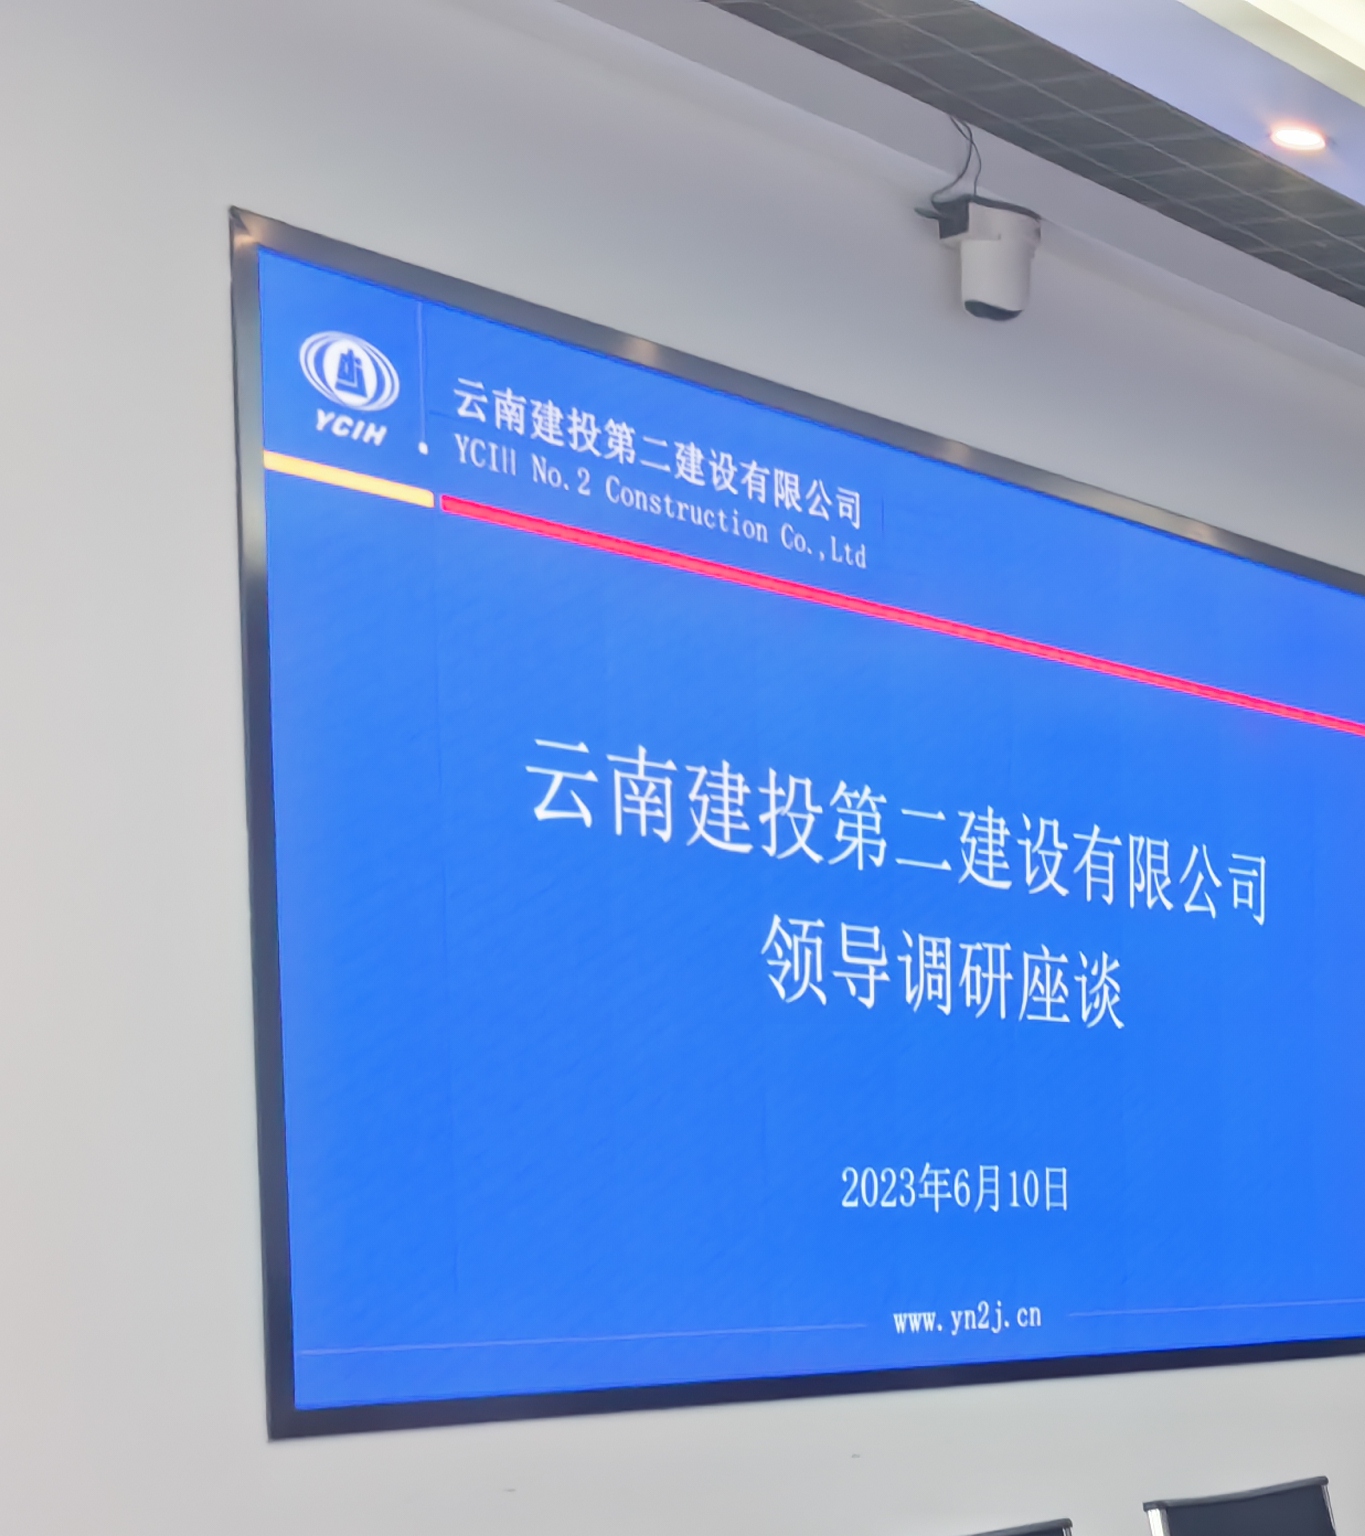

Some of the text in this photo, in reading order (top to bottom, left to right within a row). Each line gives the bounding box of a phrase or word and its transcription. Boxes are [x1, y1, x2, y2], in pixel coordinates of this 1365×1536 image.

[315, 408, 388, 446] YCIH
[453, 377, 862, 530] 云南建投第二建设有限公司
[531, 453, 591, 497] No.2
[605, 475, 769, 544] Construction
[525, 738, 1267, 927] 云南建投第二建设有限公司
[761, 913, 1126, 1029] 领导调研座谈
[841, 1162, 1069, 1213] 2023年6月10日
[892, 1300, 1043, 1337] www.yn2j.cn
